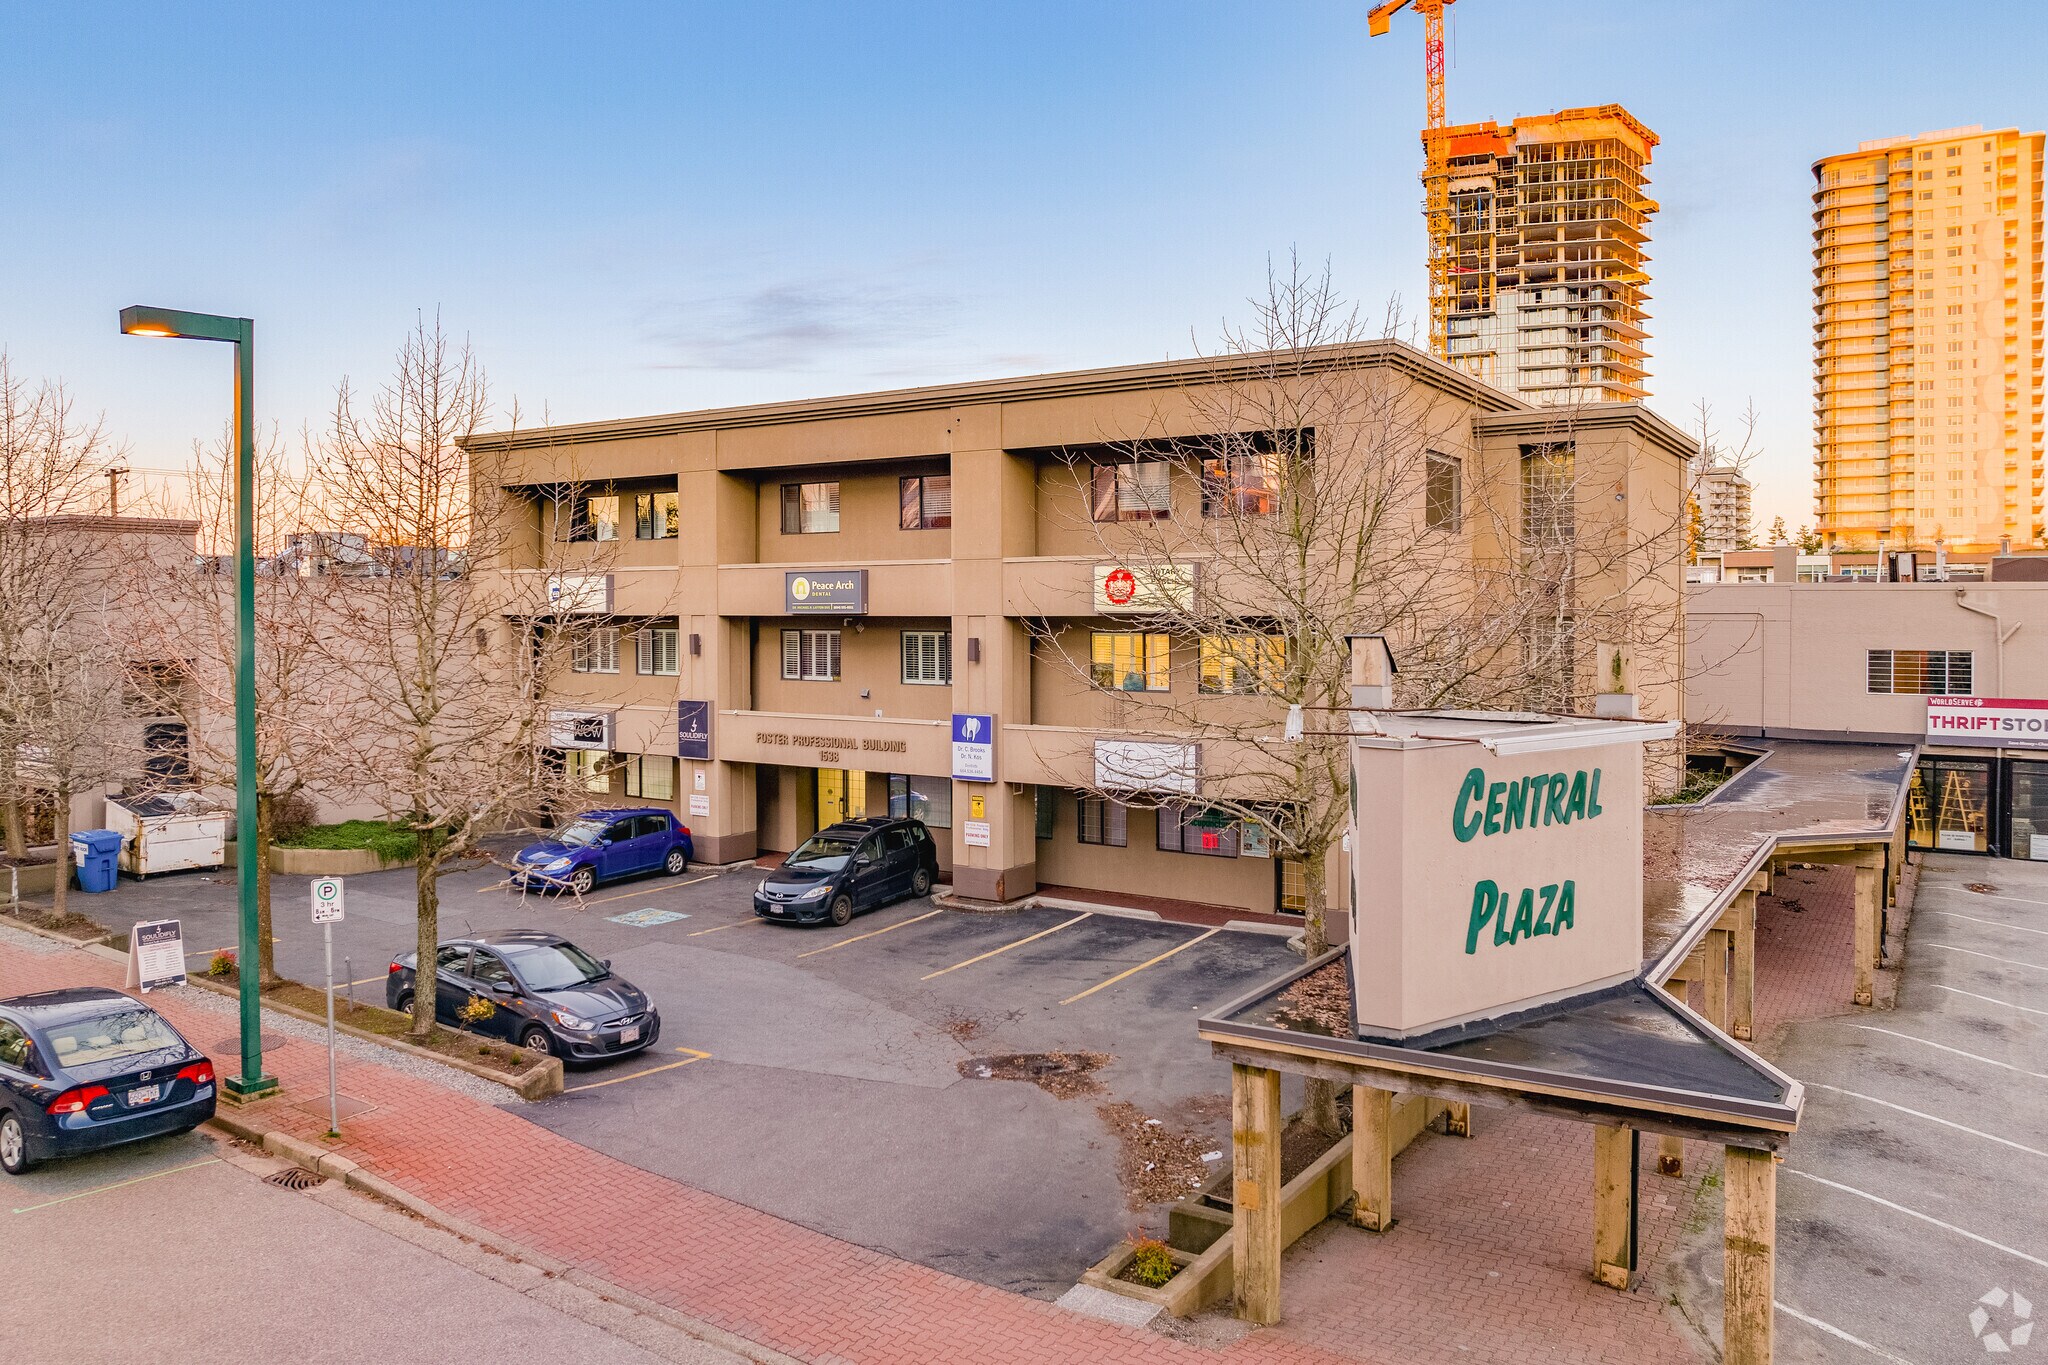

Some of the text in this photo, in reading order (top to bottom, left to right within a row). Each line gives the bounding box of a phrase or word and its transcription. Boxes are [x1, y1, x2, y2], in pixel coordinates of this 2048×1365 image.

[811, 580, 854, 590] Peace Arch
[1929, 715, 2048, 732] THRIFTSTO
[756, 732, 907, 753] FOSTER PROFESSIONAL BUILDING
[1453, 767, 1603, 842] CENTRAL
[324, 886, 332, 896] P
[1465, 879, 1575, 955] PLAZA
